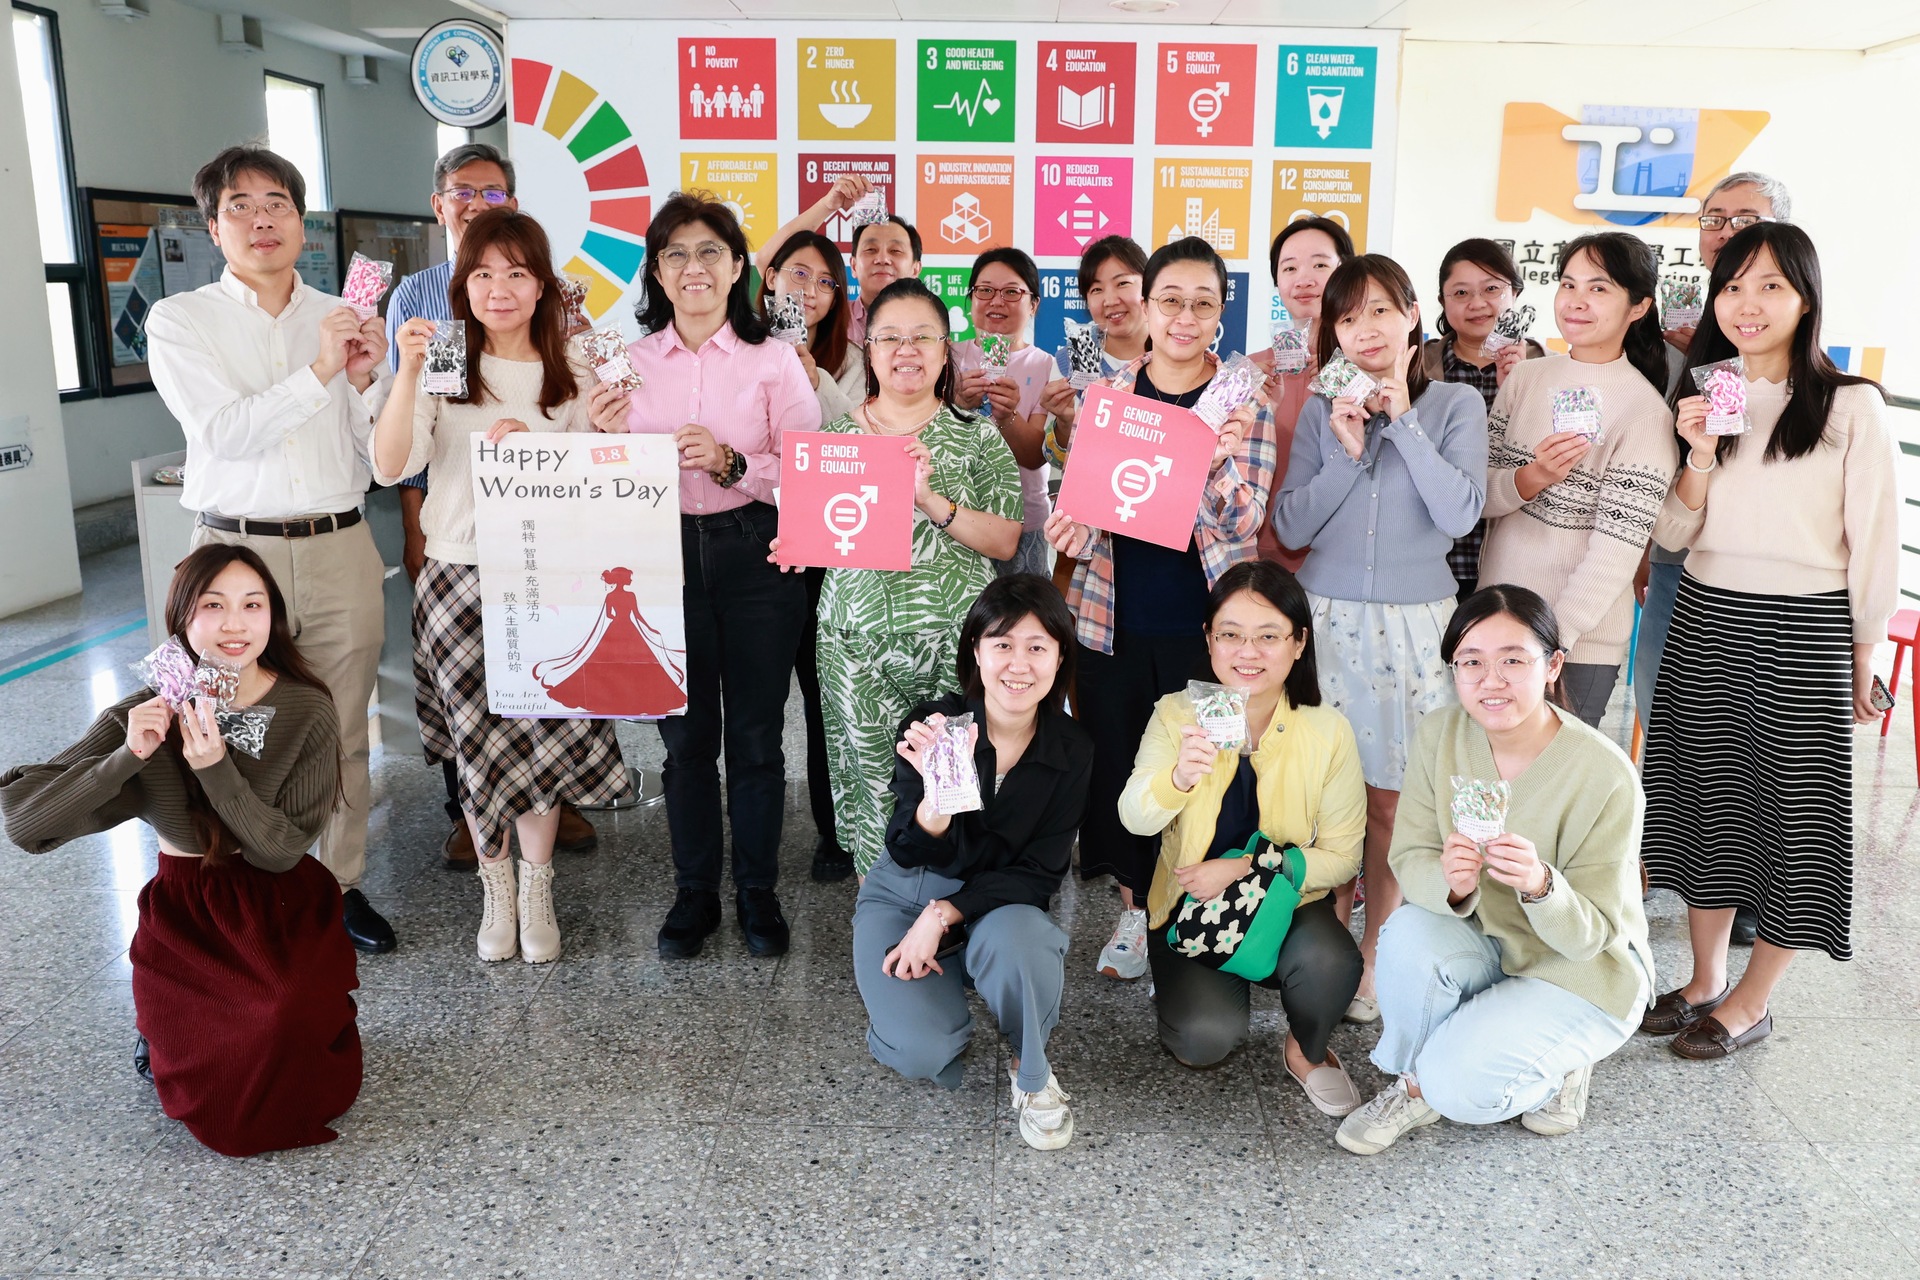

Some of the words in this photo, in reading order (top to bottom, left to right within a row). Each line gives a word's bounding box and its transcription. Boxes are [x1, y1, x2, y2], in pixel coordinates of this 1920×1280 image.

[420, 37, 441, 70] DEPARTMENT
[453, 31, 484, 44] COMPUTER
[484, 45, 498, 67] SCIENCE
[688, 45, 697, 68] 1
[705, 46, 716, 56] NO
[806, 46, 817, 68] 2
[825, 47, 844, 57] ZERO
[945, 48, 966, 58] GOOD
[967, 48, 994, 58] HEALTH
[1065, 49, 1096, 60] QUALITY
[1186, 51, 1215, 62] GENDER
[705, 58, 738, 68] POVERTY
[825, 59, 854, 69] HUNGER
[926, 47, 938, 70] 3
[945, 60, 961, 70] AND
[962, 60, 1004, 71] WELL-BEING
[1046, 49, 1058, 71] 4
[1167, 50, 1178, 73] 5
[1286, 53, 1299, 76] 6
[1305, 53, 1329, 64] CLEAN
[1330, 54, 1355, 65] WATER
[1065, 62, 1106, 72] EDUCATION
[1186, 64, 1221, 74] EQUALITY
[1305, 66, 1321, 76] AND
[1321, 67, 1364, 77] SANITATION
[431, 69, 490, 83] 資訊工程學系
[433, 99, 471, 114] INFORMATION
[473, 82, 499, 112] ENGINEERING
[690, 160, 699, 182] 7
[707, 161, 752, 170] AFFORDABLE
[753, 161, 768, 171] AND
[806, 160, 818, 183] 8
[823, 161, 850, 171] DECENT
[851, 162, 873, 171] WORK
[873, 162, 889, 172] AND
[924, 161, 936, 184] 9
[973, 163, 1012, 173] INNOVATION
[1066, 164, 1099, 174] REDUCED
[1180, 166, 1227, 177] SUSTAINABLE
[1228, 167, 1249, 177] CITIES
[707, 172, 730, 182] CLEAN
[731, 173, 758, 183] ENERGY
[939, 175, 955, 184] AND
[955, 175, 1010, 185] INFRASTRUCTURE
[1041, 164, 1060, 186] 10
[1160, 166, 1175, 188] 11
[1279, 168, 1297, 190] 12
[1303, 168, 1349, 179] RESPONSIBLE
[1066, 176, 1113, 187] INEQUALITIES
[1180, 178, 1195, 188] AND
[1196, 179, 1243, 189] COMMUNITIES
[1303, 181, 1352, 191] CONSUMPTION
[1302, 193, 1319, 203] AND
[1320, 193, 1362, 203] PRODUCTION
[924, 275, 942, 297] 15
[947, 275, 962, 285] LIFE
[1041, 276, 1060, 298] 16
[947, 286, 961, 296] ON
[1094, 398, 1114, 429] 5
[1123, 405, 1163, 428] GENDER
[1118, 421, 1167, 445] EQUALITY
[478, 440, 570, 472] Happy
[595, 448, 621, 463] 3.8
[795, 442, 810, 472] 5
[821, 444, 859, 459] GENDER
[820, 460, 867, 475] EQUALITY
[479, 476, 602, 498] Women's
[612, 478, 668, 508] Day
[521, 519, 537, 543] 獨特
[523, 547, 539, 571] 智慧
[525, 575, 541, 623] 充滿活力
[503, 591, 523, 673] 致天生麗質的妳
[495, 689, 515, 699] You
[519, 689, 540, 699] Are
[495, 701, 548, 713] Beautiful
